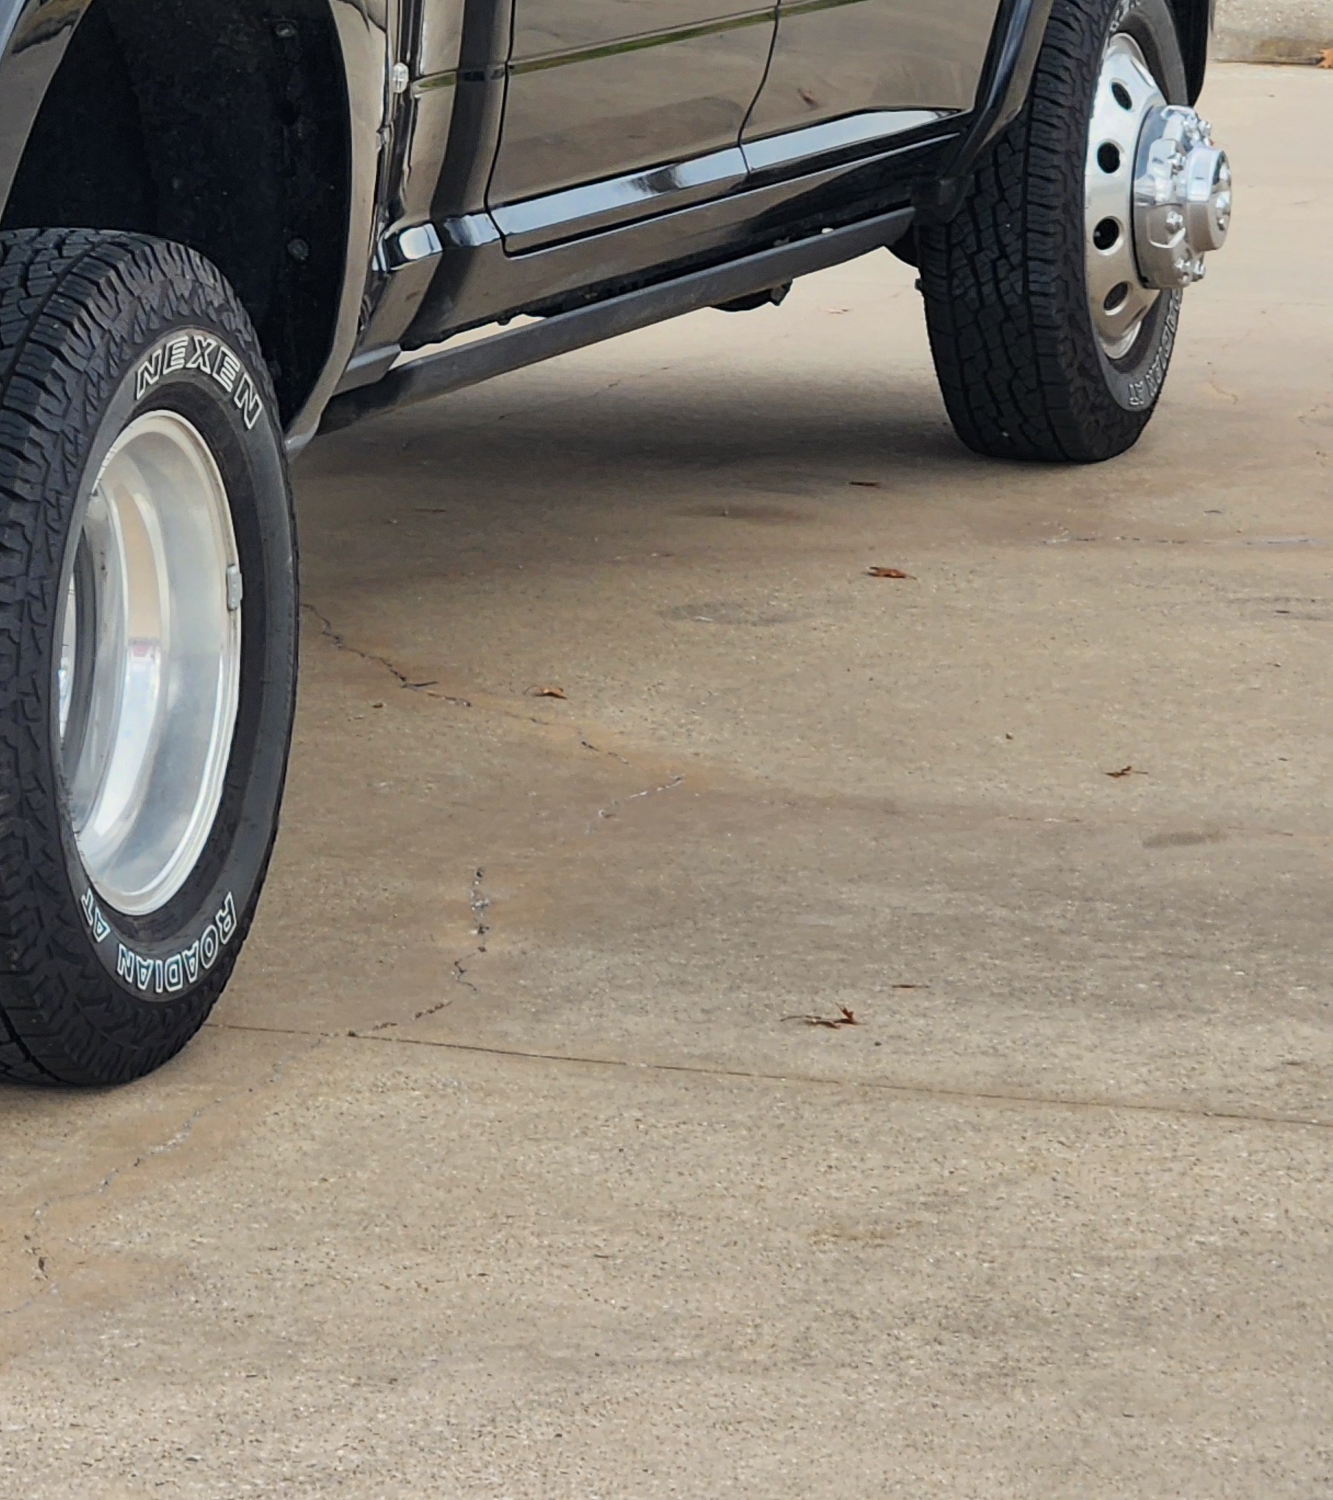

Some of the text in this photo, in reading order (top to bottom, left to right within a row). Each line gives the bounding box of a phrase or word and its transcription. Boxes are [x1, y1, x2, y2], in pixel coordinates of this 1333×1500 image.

[136, 335, 263, 430] NEXEN
[81, 887, 237, 993] ROADIAN AT
